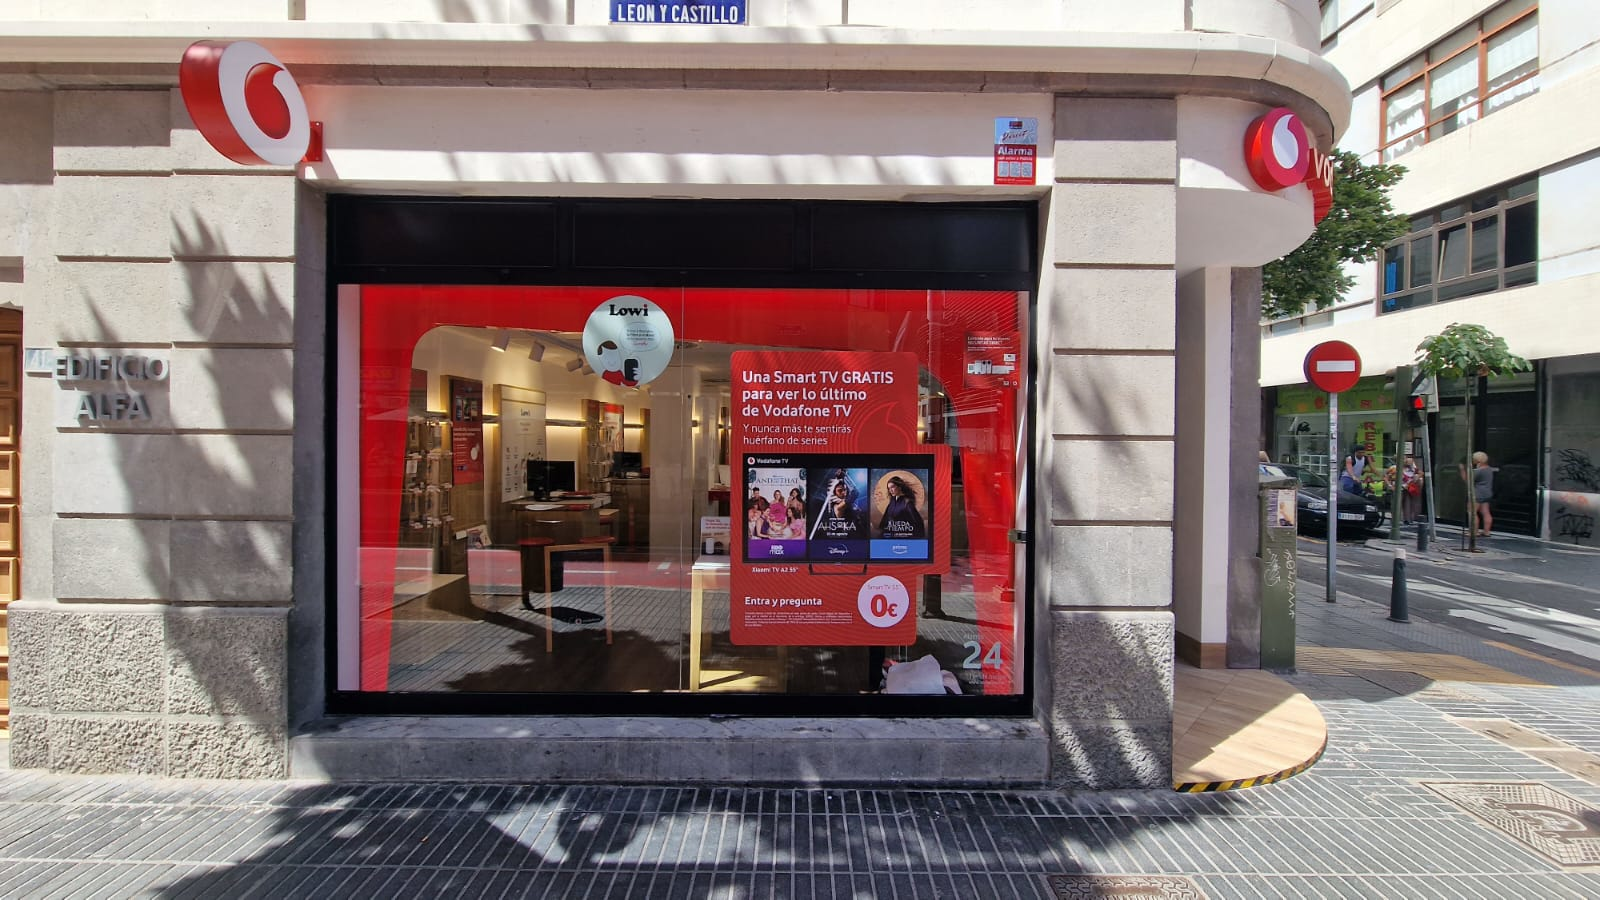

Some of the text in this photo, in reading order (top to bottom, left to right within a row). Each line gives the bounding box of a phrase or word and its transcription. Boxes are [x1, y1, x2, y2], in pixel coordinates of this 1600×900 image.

[617, 3, 739, 23] LEON Y CASTILLO
[997, 146, 1033, 156] Alarma
[608, 303, 649, 317] Lowi
[53, 355, 170, 382] EDIFICIO
[742, 370, 894, 384] Una Smart TV GRATIS
[742, 386, 867, 402] para ver lo último
[74, 394, 152, 420] ALFA
[741, 404, 852, 417] de Vodafone TV
[742, 424, 852, 433] Y nunca más te sentirás
[743, 435, 828, 446] huérfano de series
[744, 596, 823, 608] Entra y pregunta
[962, 640, 1004, 670] 24
